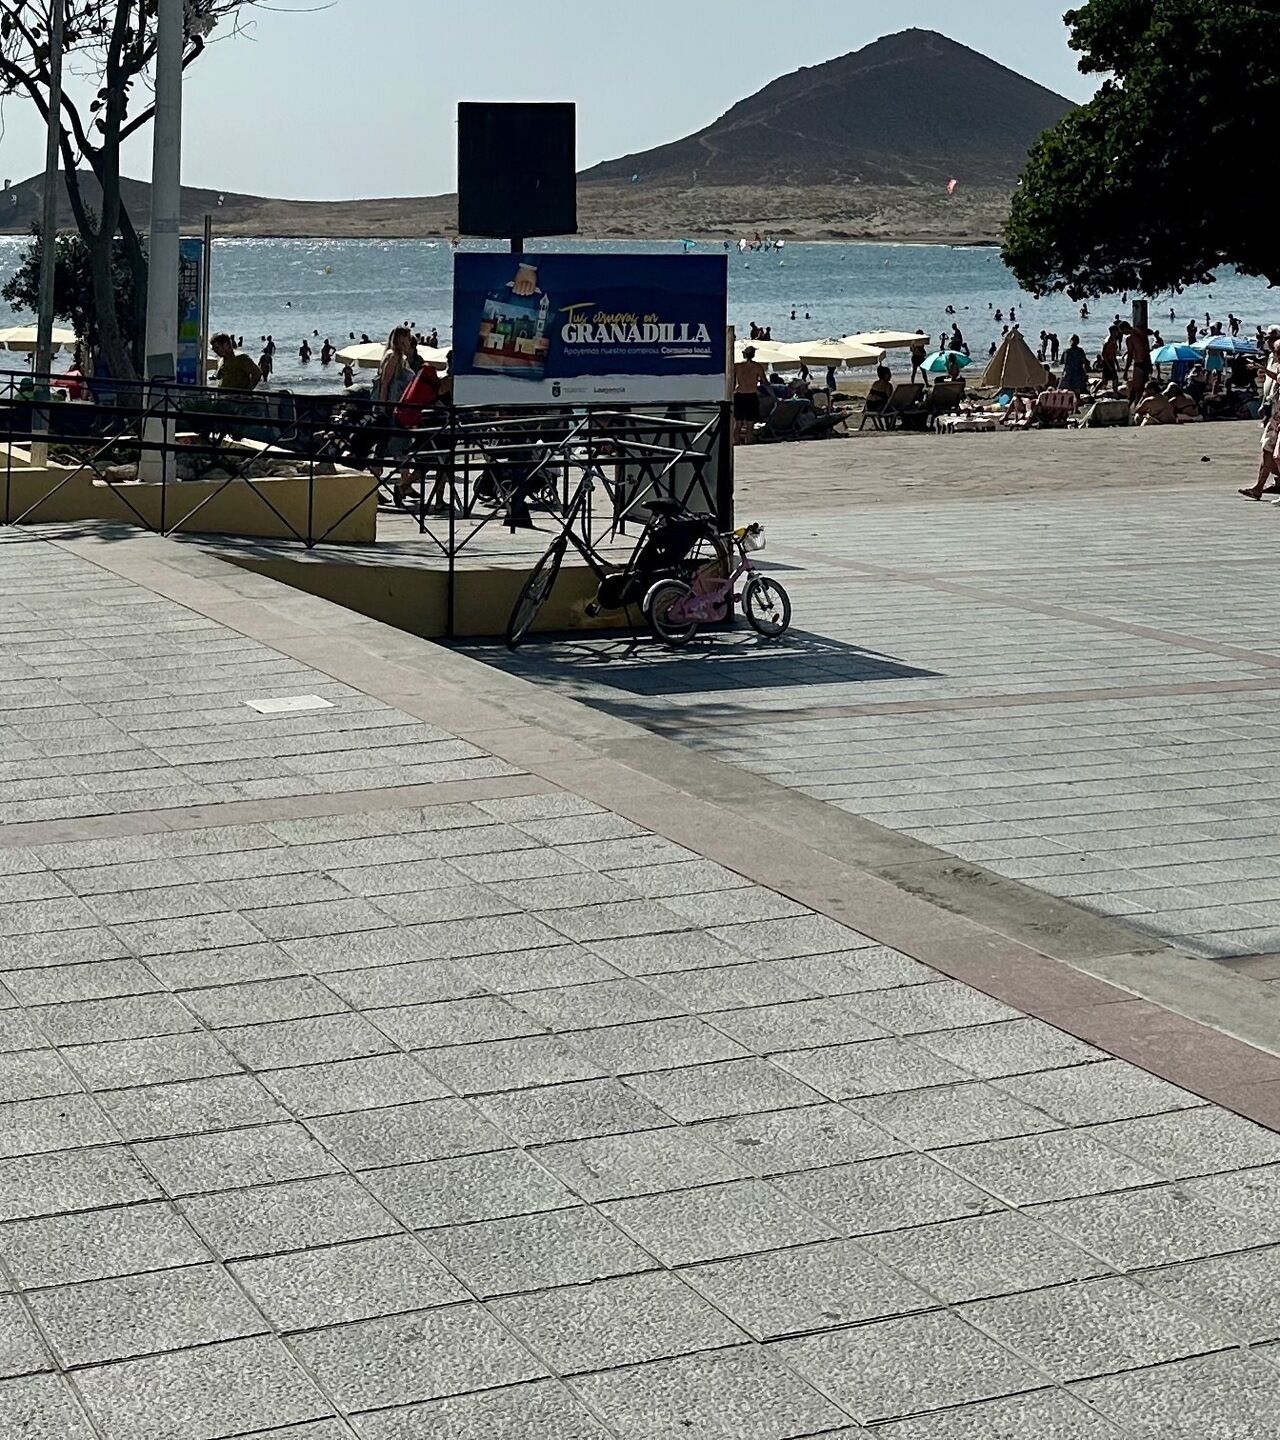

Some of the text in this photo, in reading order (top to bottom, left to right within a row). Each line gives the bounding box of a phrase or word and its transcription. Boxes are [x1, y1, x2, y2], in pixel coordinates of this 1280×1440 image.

[559, 302, 596, 324] Tus
[643, 312, 659, 323] en
[561, 322, 712, 343] GRANADILLA
